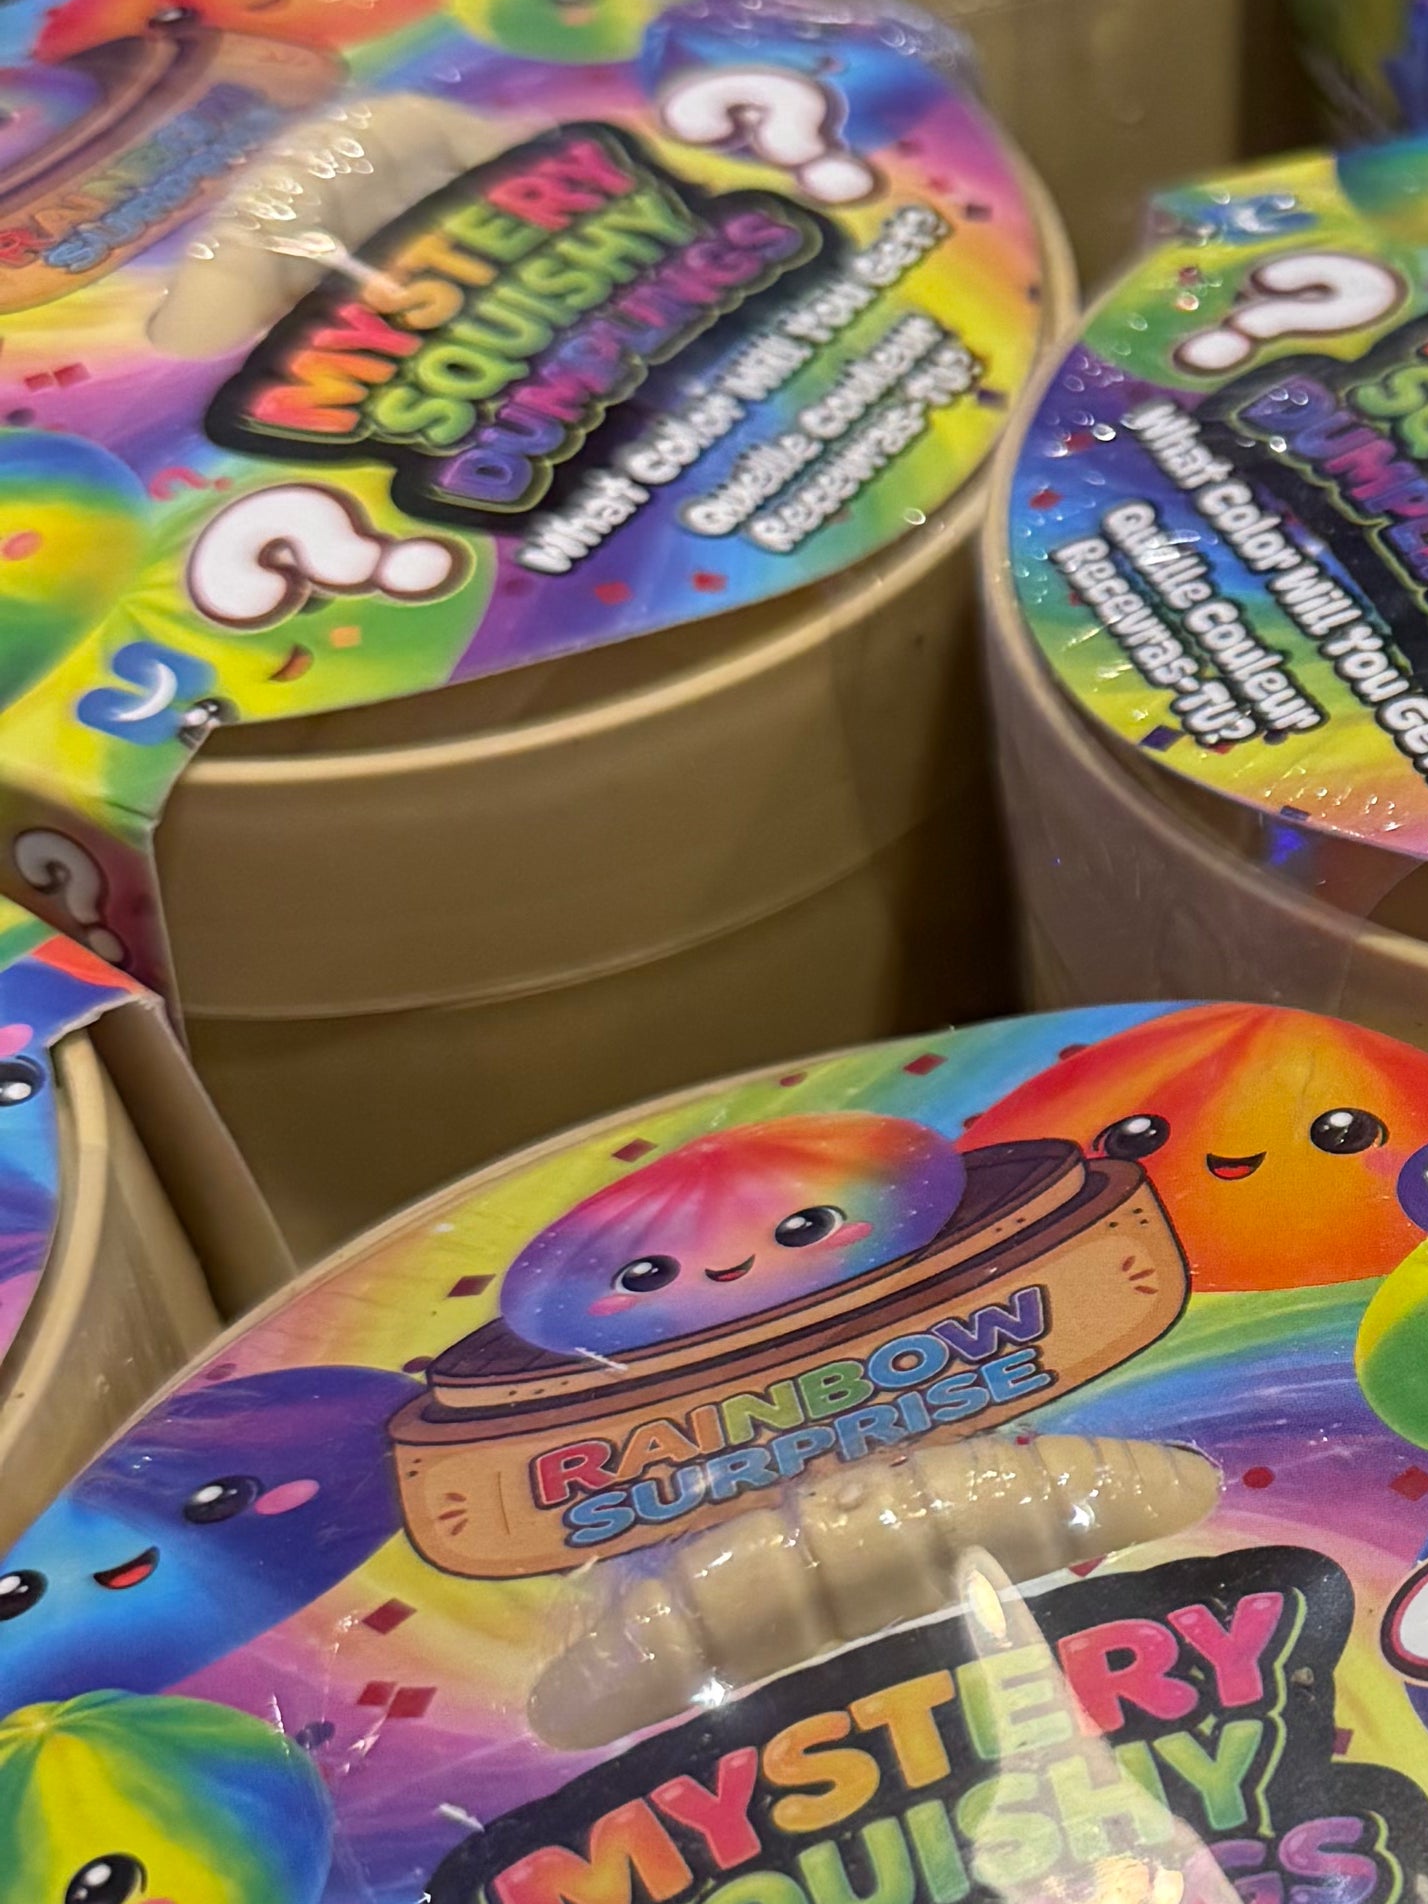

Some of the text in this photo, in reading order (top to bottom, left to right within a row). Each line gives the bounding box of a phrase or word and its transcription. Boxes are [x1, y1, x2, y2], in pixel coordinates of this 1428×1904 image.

[251, 141, 634, 432] MYSTERY
[375, 192, 695, 444] SQUISHY
[1104, 504, 1321, 730] Quelle Couleur
[1132, 401, 1233, 489] What
[1199, 483, 1300, 571] Color
[1269, 564, 1361, 636] Will
[1325, 626, 1410, 702] You
[538, 1287, 1045, 1504] RAINBOW
[566, 1349, 1052, 1545] SURPRISE
